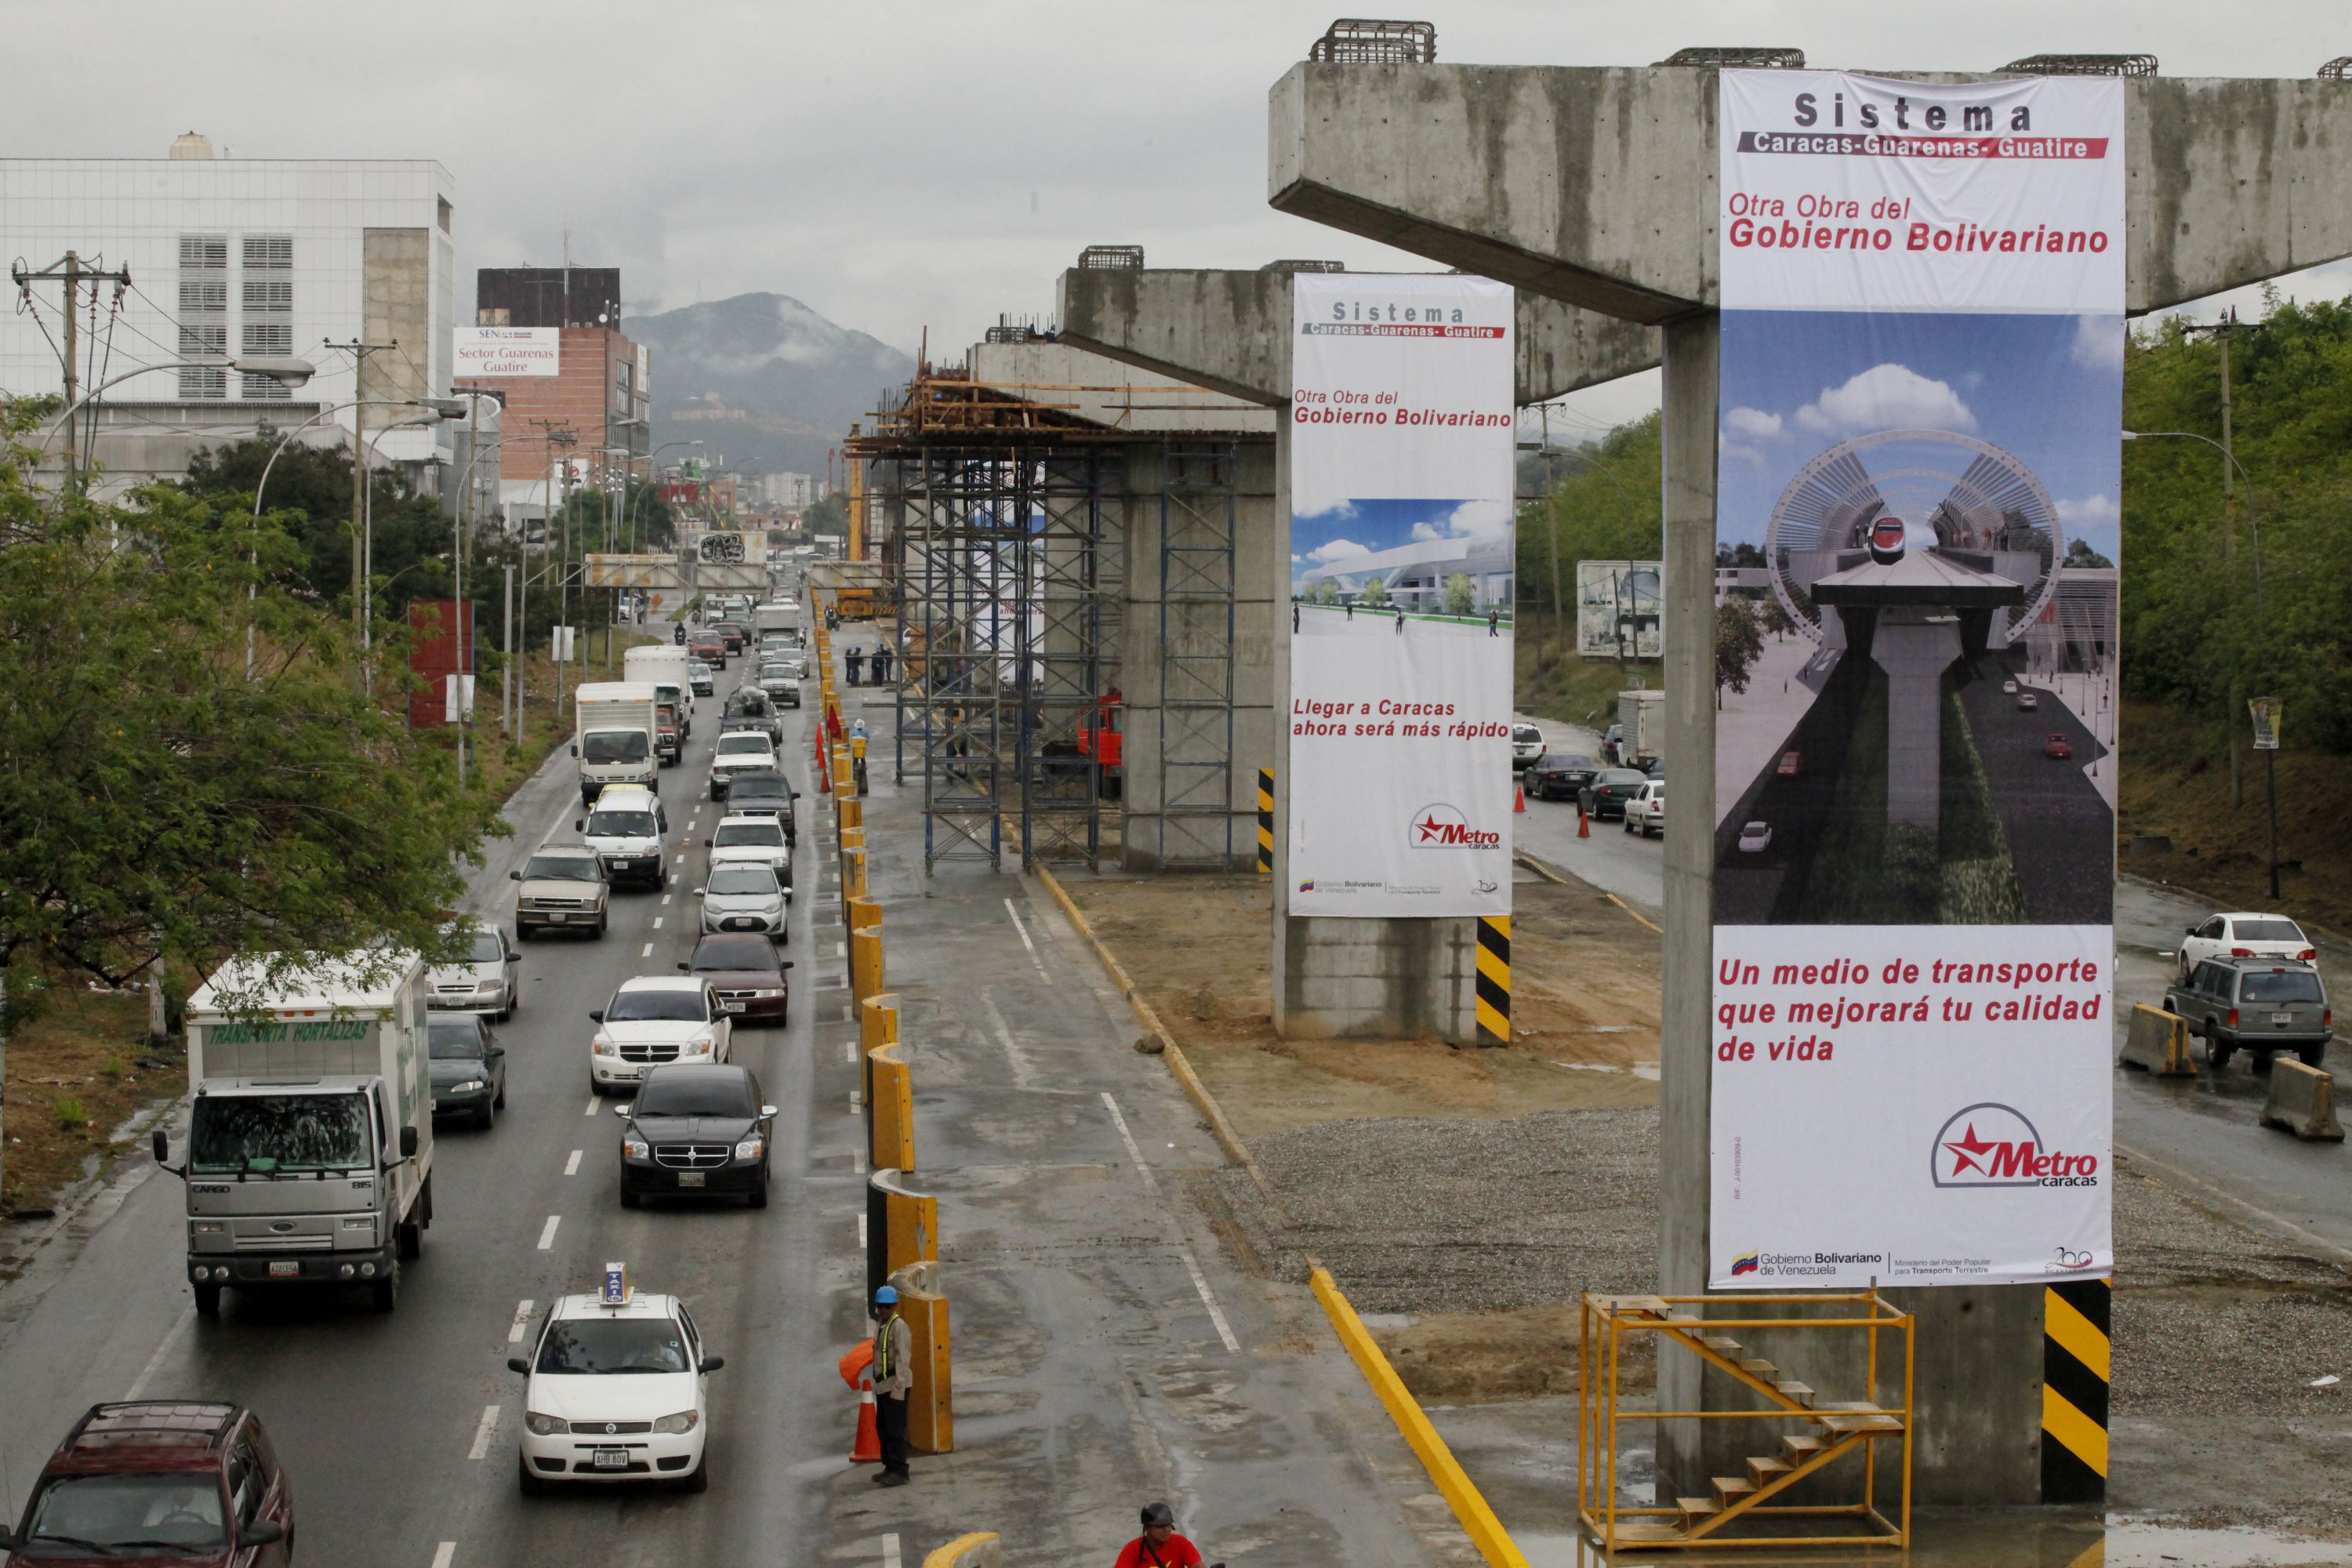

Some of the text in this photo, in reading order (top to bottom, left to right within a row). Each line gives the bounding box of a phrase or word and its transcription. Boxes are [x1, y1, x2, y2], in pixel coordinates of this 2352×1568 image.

[1794, 93, 2031, 132] Sistema
[1998, 136, 2088, 158] Guatire
[1730, 192, 1911, 220] Otra Obra del
[1730, 218, 2108, 253] Gobierno Bolivariano
[1333, 302, 1464, 323] Sistema
[1444, 326, 1494, 338] Guatire
[459, 347, 554, 359] Sector Guarenas
[483, 361, 528, 372] Guatire
[1294, 389, 1398, 405] Otra Obra del
[1294, 406, 1512, 426] Gobierno Bolivariano
[1294, 699, 1455, 718] Llegar a Caracas
[1293, 720, 1508, 740] ahora será más rápido
[1440, 824, 1500, 844] Metro
[1719, 957, 2098, 989] Un medio de transporte
[1718, 994, 2102, 1029] que mejorará tu calidad
[292, 1021, 369, 1042] HORTALIZAS
[1718, 1034, 1834, 1061] de vida
[1988, 1141, 2098, 1178] Metro
[2042, 1176, 2098, 1187] caracas
[1760, 1252, 1882, 1265] Gobierno Bolivariano
[1964, 1258, 1991, 1268] Popular
[1760, 1265, 1836, 1276] de Venezuela
[1912, 1267, 1953, 1276] Transporte
[609, 1273, 620, 1295] TAXI
[597, 1454, 610, 1464] AHB
